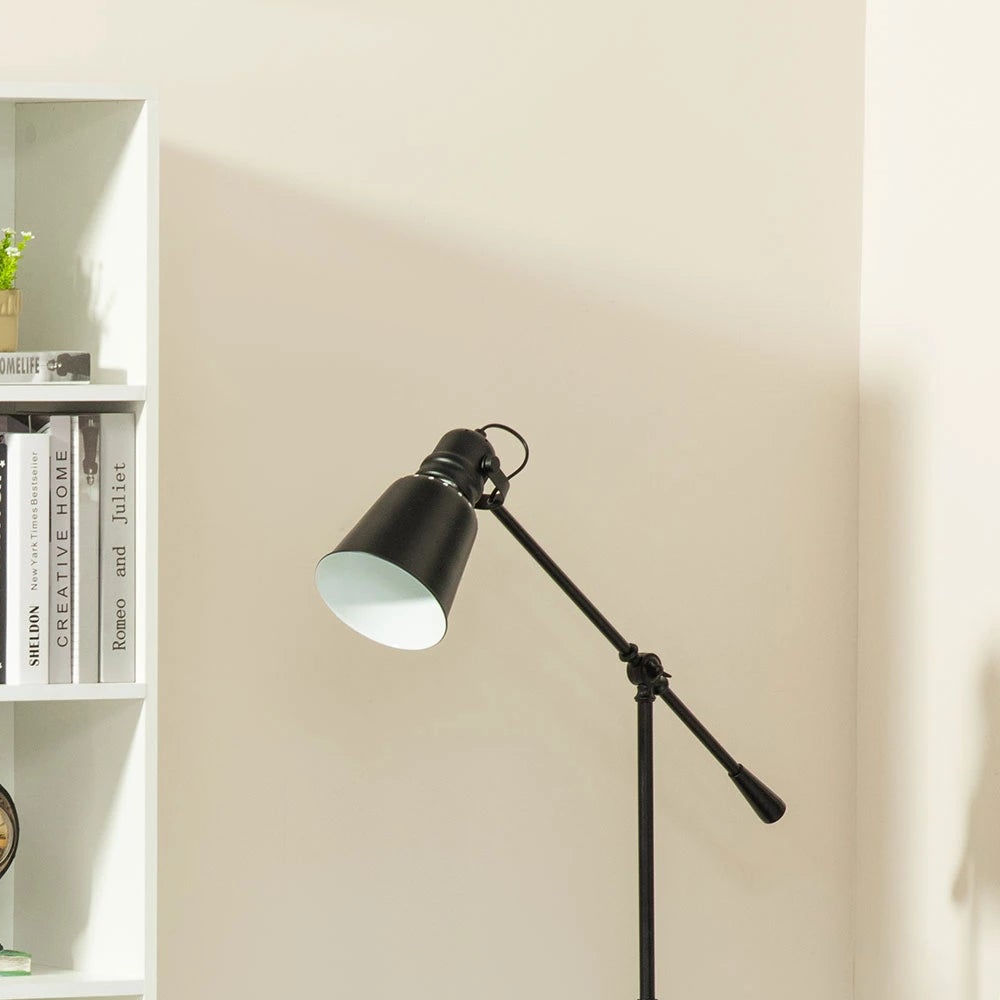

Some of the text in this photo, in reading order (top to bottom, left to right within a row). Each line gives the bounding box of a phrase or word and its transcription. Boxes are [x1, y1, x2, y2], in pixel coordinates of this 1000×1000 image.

[29, 605, 40, 667] SHELDON
[55, 451, 69, 648] CREATIVE HOME
[112, 463, 127, 651] Romeo and Juliet
